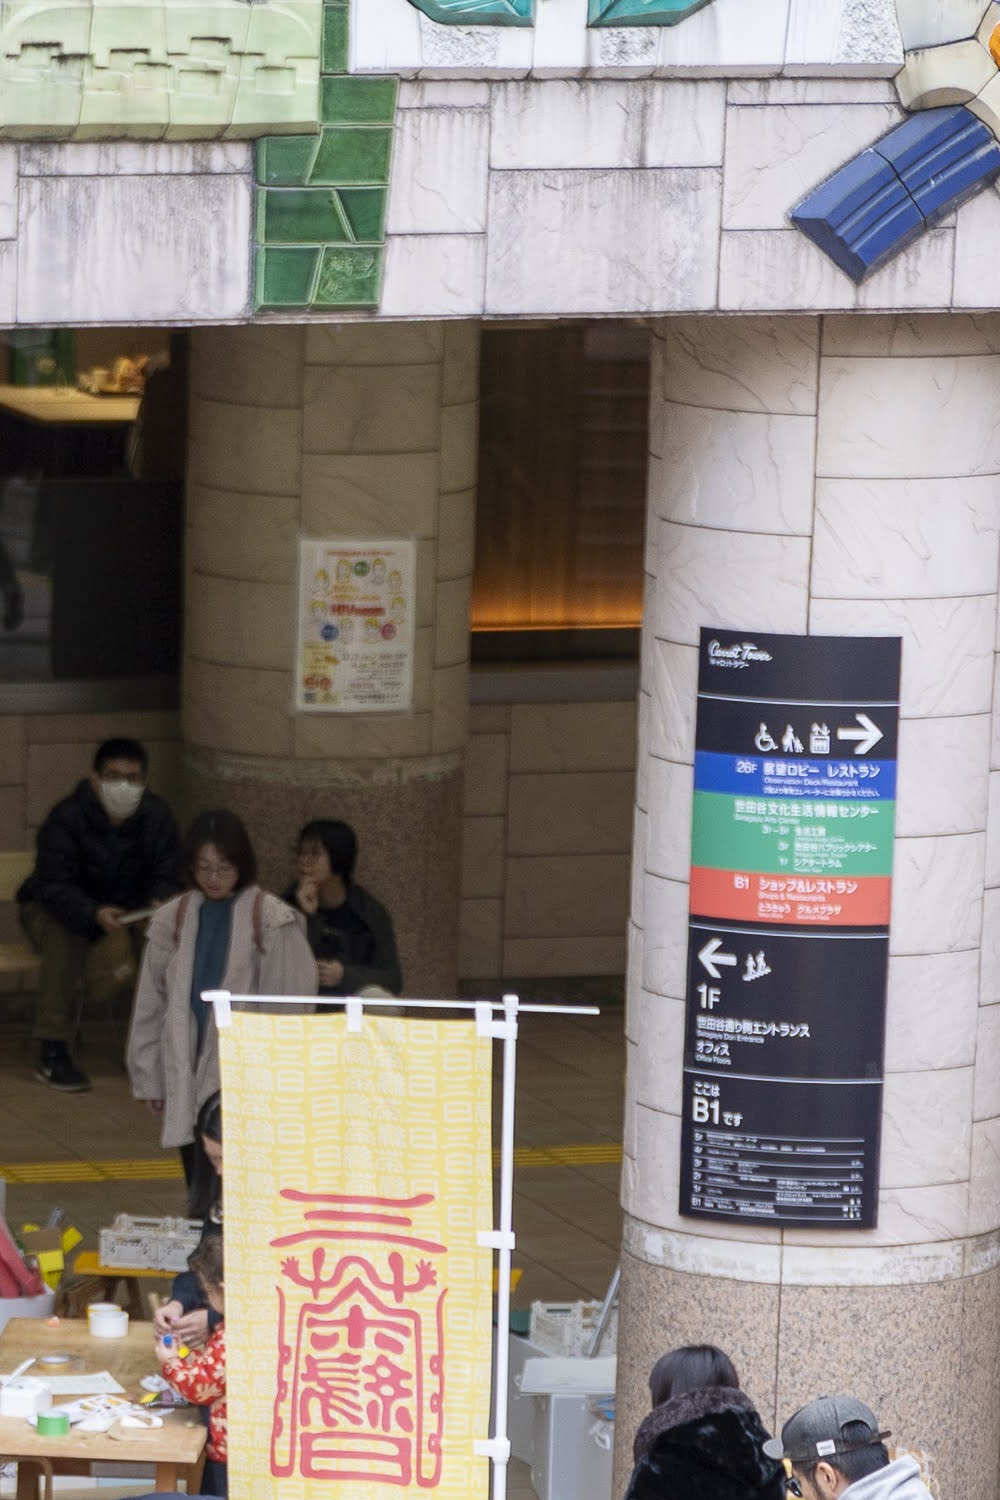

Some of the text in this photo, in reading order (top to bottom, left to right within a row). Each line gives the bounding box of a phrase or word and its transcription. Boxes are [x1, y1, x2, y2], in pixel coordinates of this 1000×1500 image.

[708, 640, 773, 661] Carrot Tower
[736, 760, 880, 778] 26F 展望ロビー レストラン
[735, 800, 879, 818] 世田谷文化生活情報センター
[794, 858, 843, 868] シアタートラム
[734, 874, 750, 889] B1
[697, 983, 721, 1009] 1F
[696, 1014, 811, 1038] 世田谷通り側エントランス
[696, 1041, 730, 1056] オフィス
[694, 1082, 720, 1097] ここは
[692, 1097, 743, 1126] B1 です
